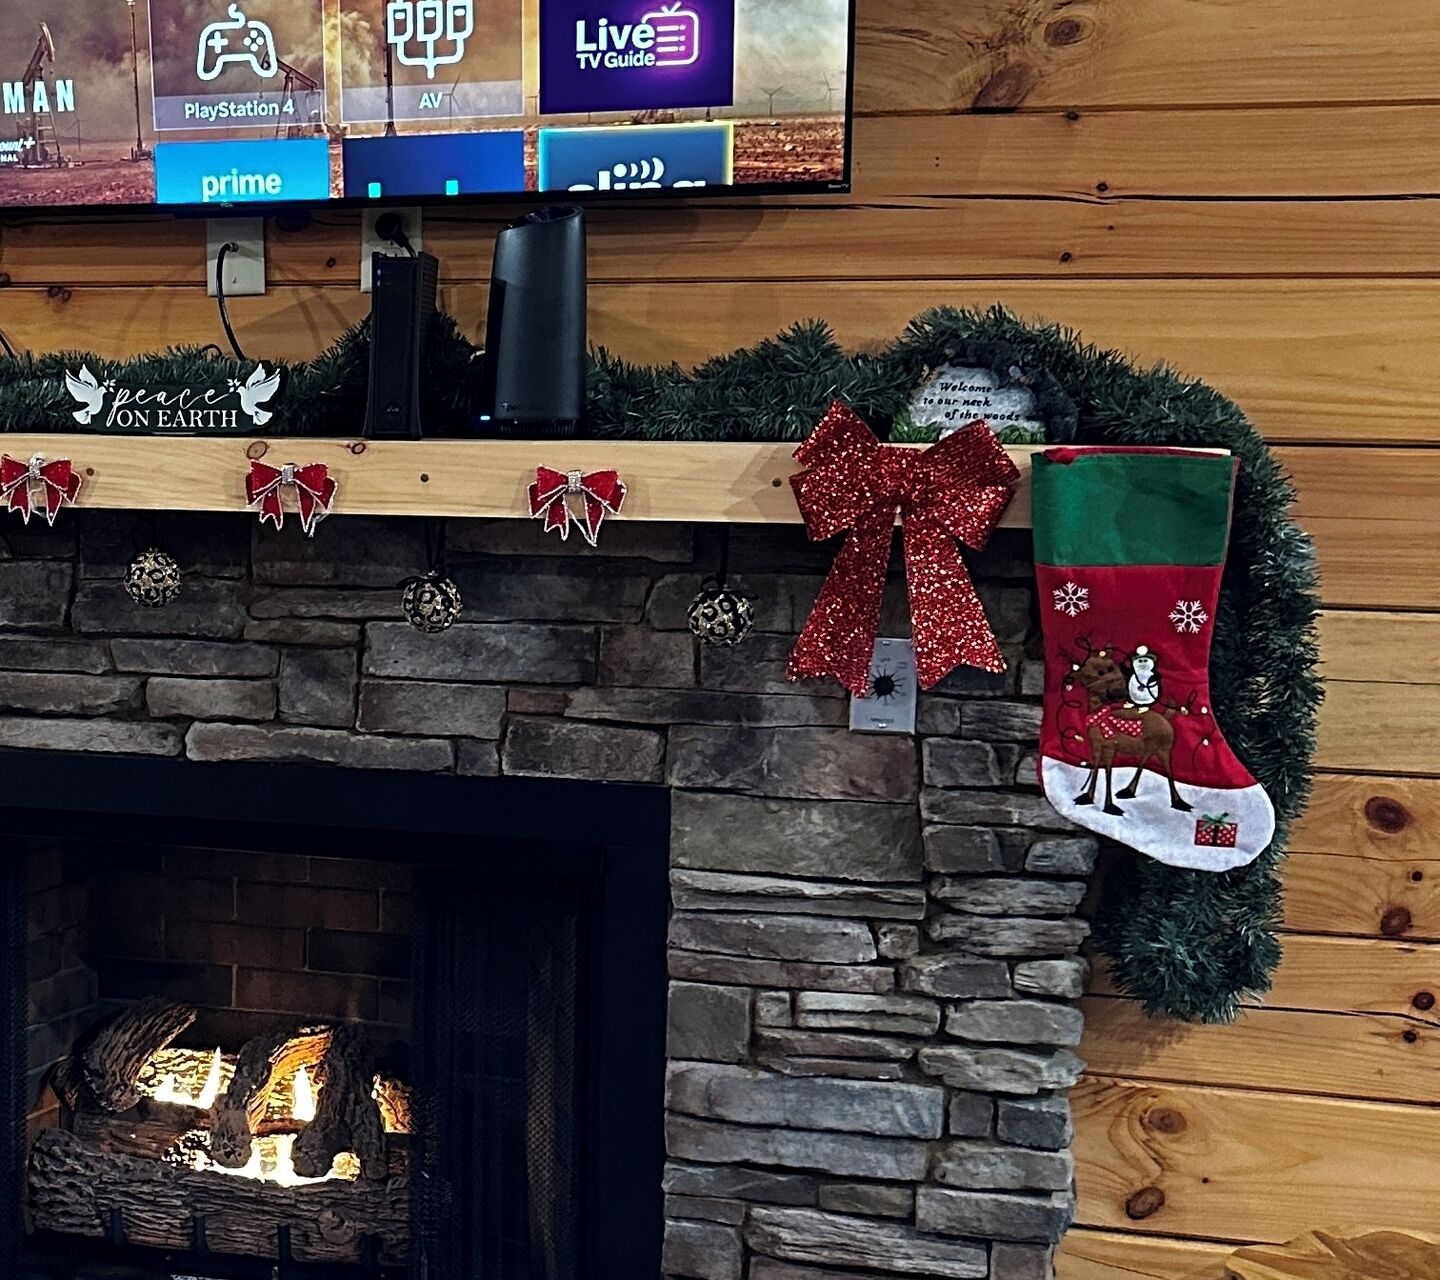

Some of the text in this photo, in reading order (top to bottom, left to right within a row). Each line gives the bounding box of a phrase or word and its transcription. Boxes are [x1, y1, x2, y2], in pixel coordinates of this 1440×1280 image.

[576, 18, 655, 52] Live
[576, 50, 656, 70] TV Guide
[184, 99, 295, 121] PlayStation 4
[419, 92, 443, 109] AV
[202, 168, 283, 202] prime
[940, 382, 993, 393] Welcome
[106, 387, 230, 428] peace
[923, 397, 934, 405] to
[116, 409, 238, 428] ON EARTH
[944, 409, 1020, 421] of the woods
